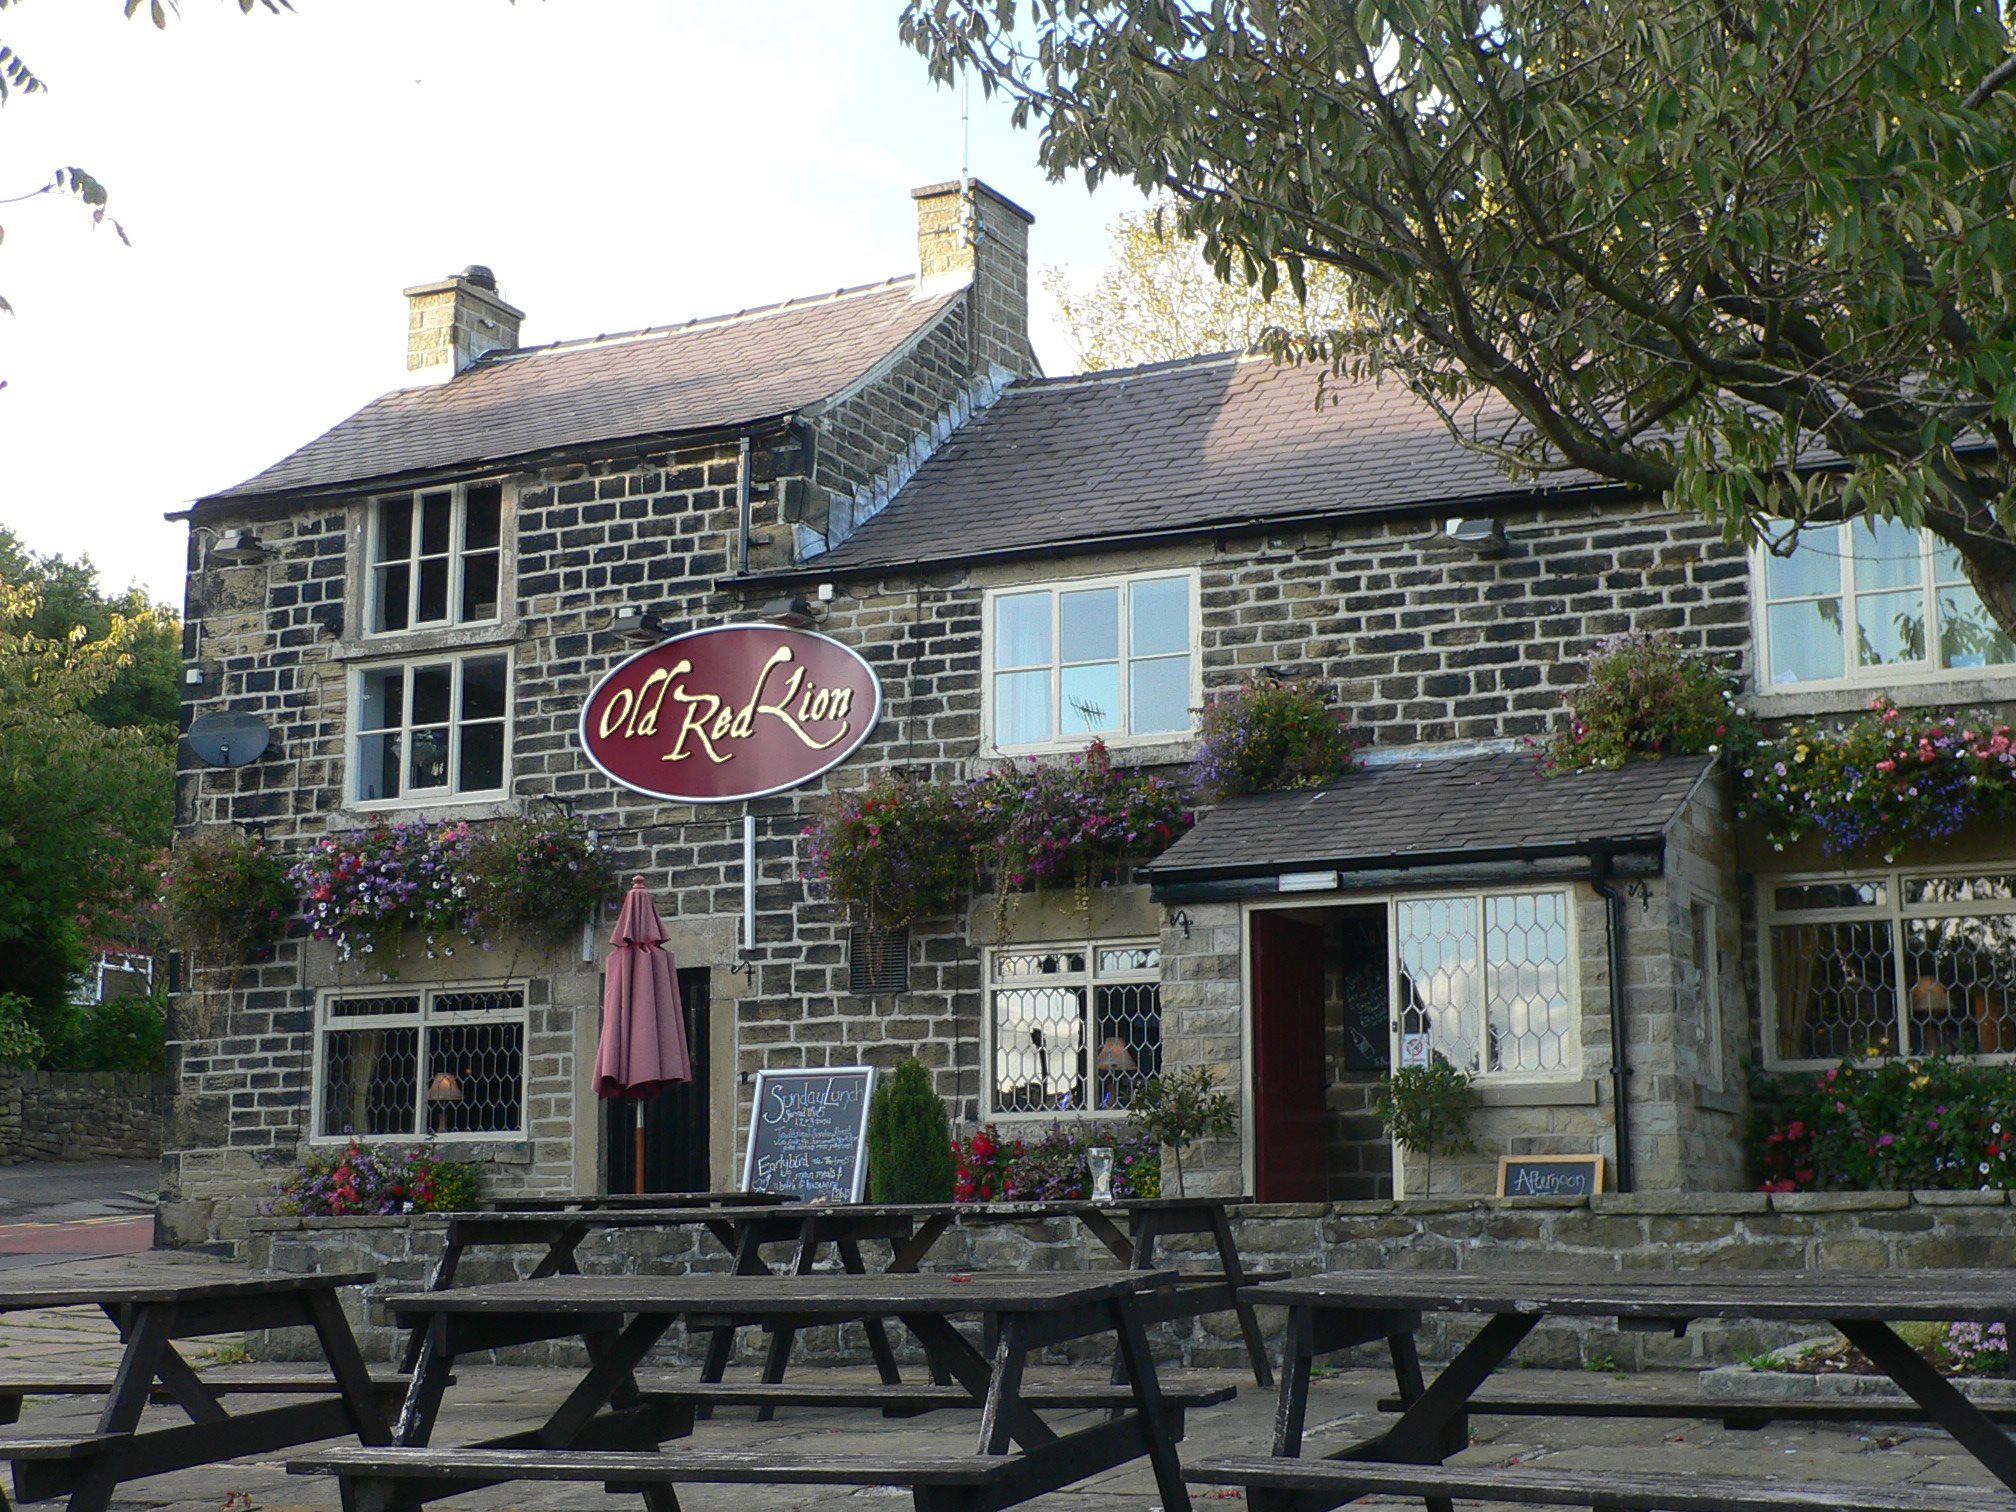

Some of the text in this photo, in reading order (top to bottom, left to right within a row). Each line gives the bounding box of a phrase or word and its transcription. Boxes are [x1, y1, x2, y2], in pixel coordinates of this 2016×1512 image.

[600, 645, 852, 763] Old Red Lion
[763, 1078, 864, 1123] Sunday Lunch
[1514, 1167, 1586, 1196] Afternoon
